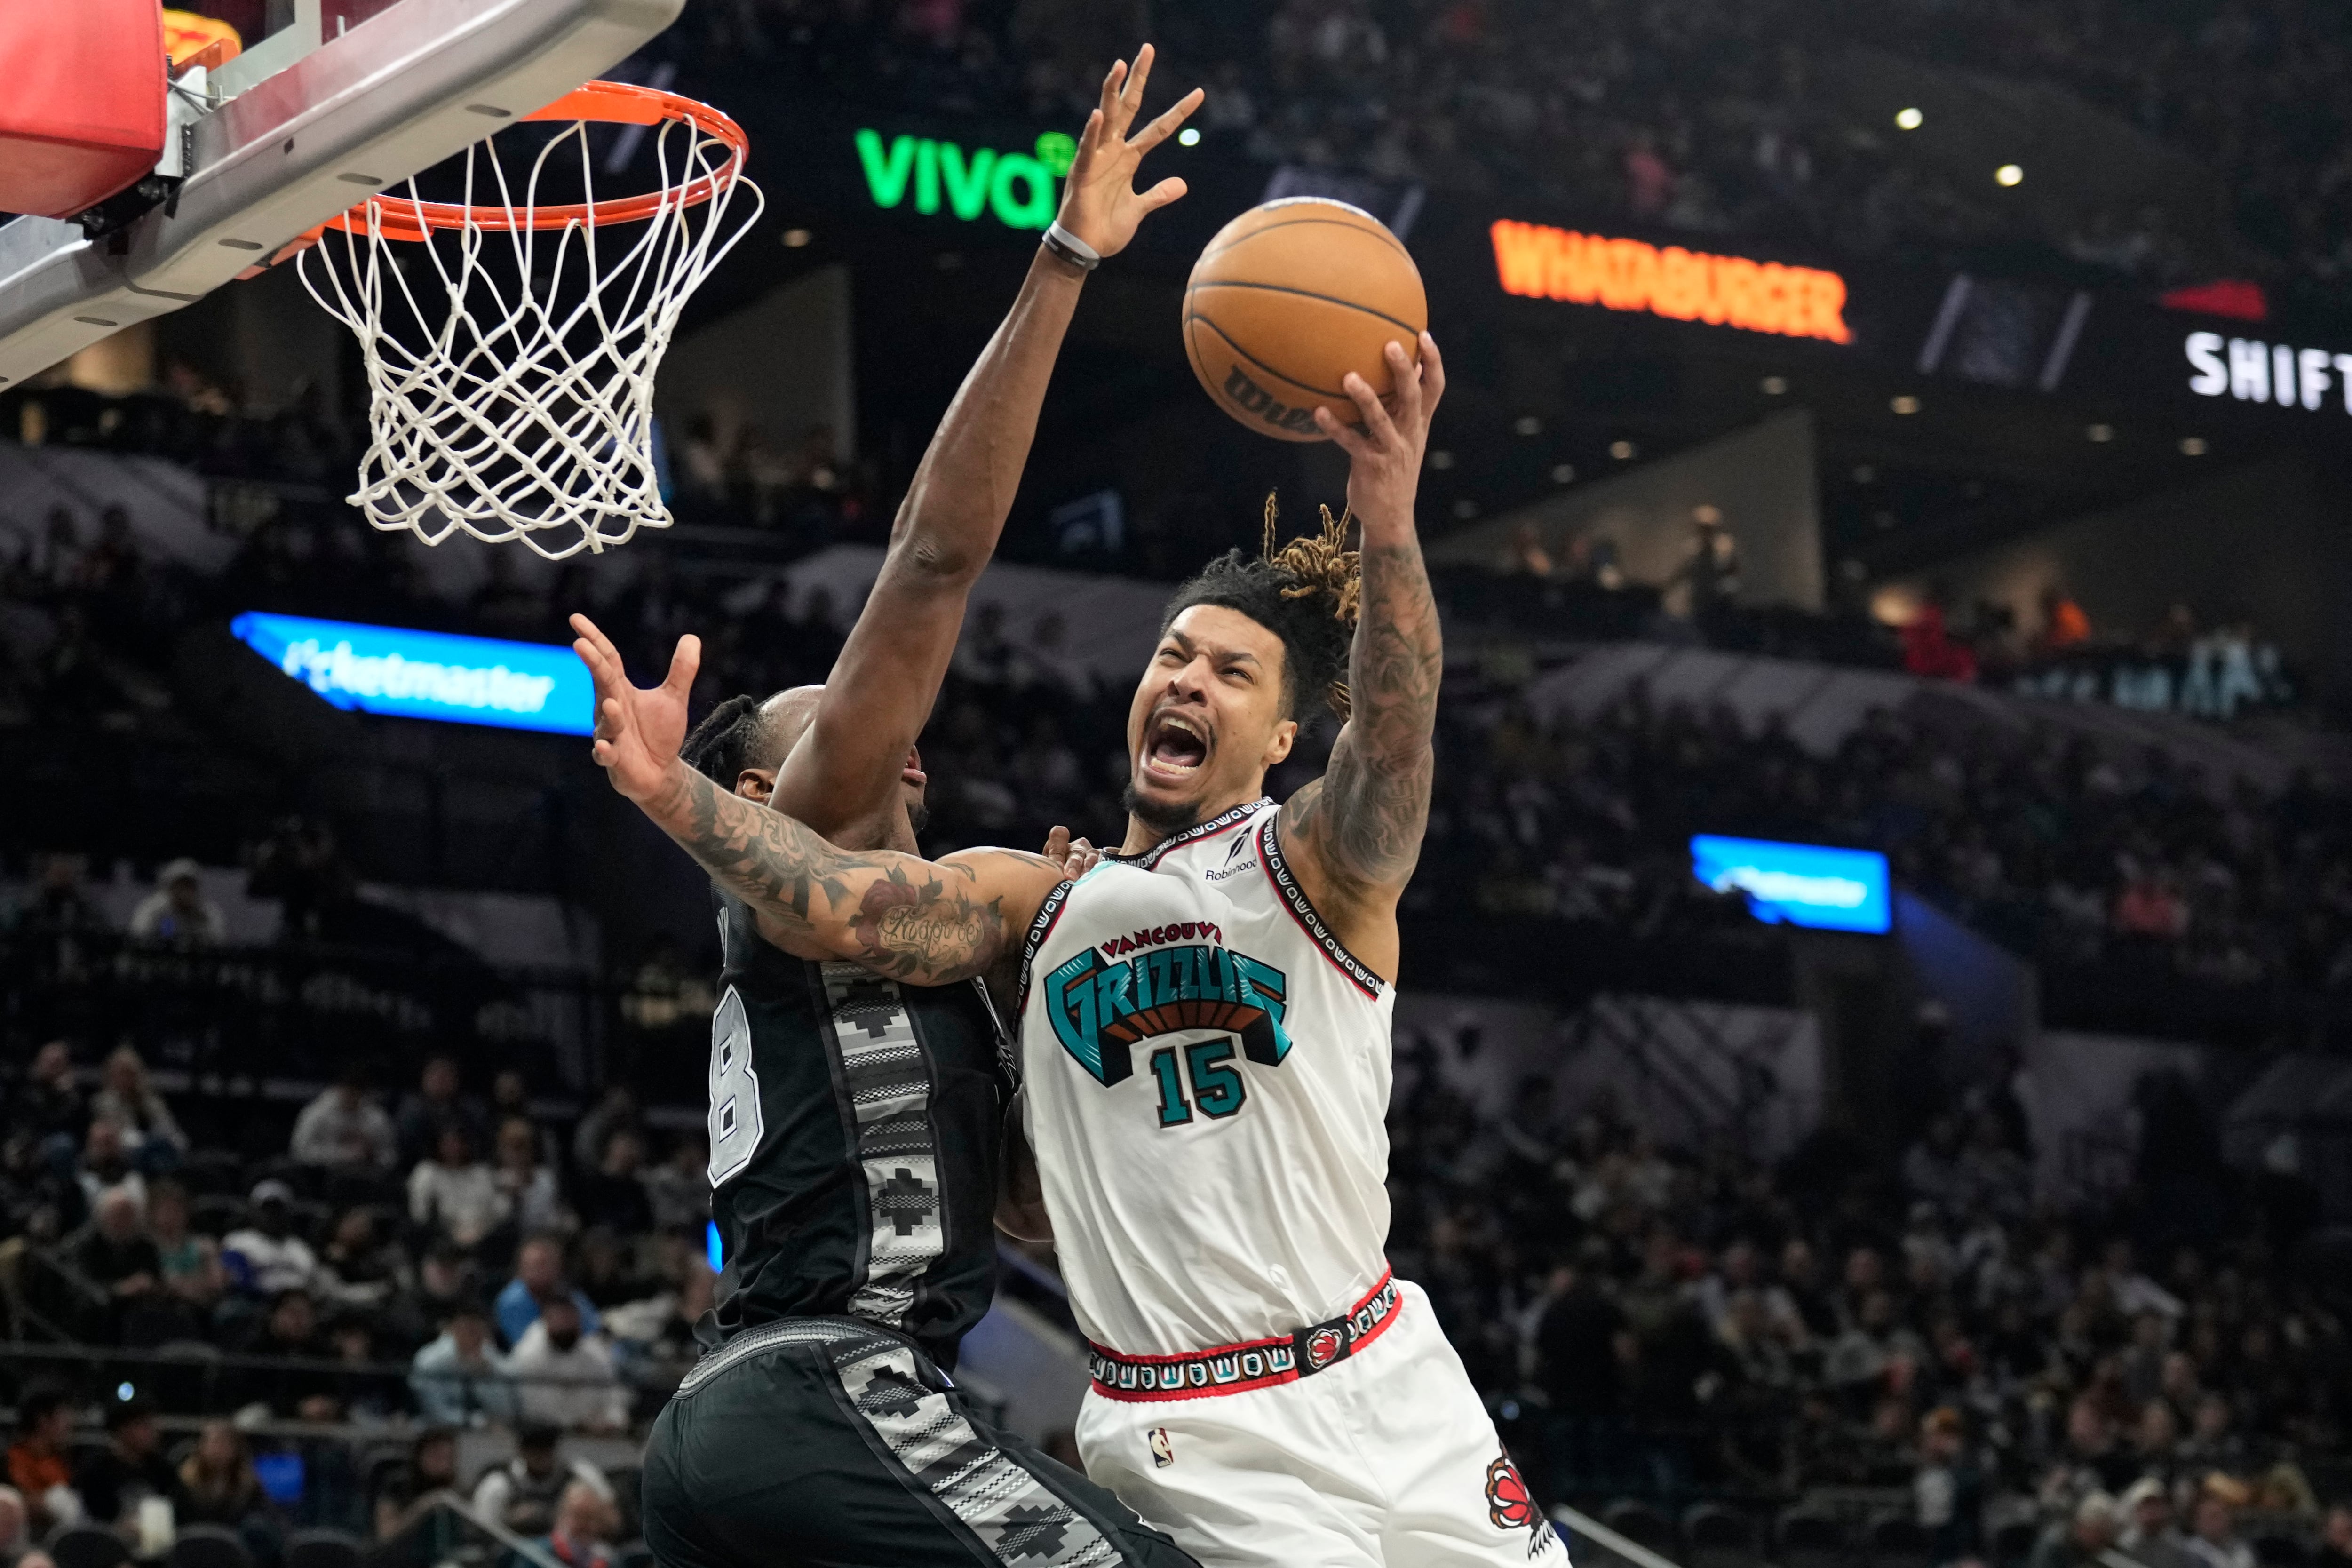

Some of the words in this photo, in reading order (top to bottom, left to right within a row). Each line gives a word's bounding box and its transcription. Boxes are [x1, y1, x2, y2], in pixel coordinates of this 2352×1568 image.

[1490, 219, 1852, 344] WHATABURGER
[707, 983, 764, 1189] 8
[1150, 1036, 1247, 1128] 15
